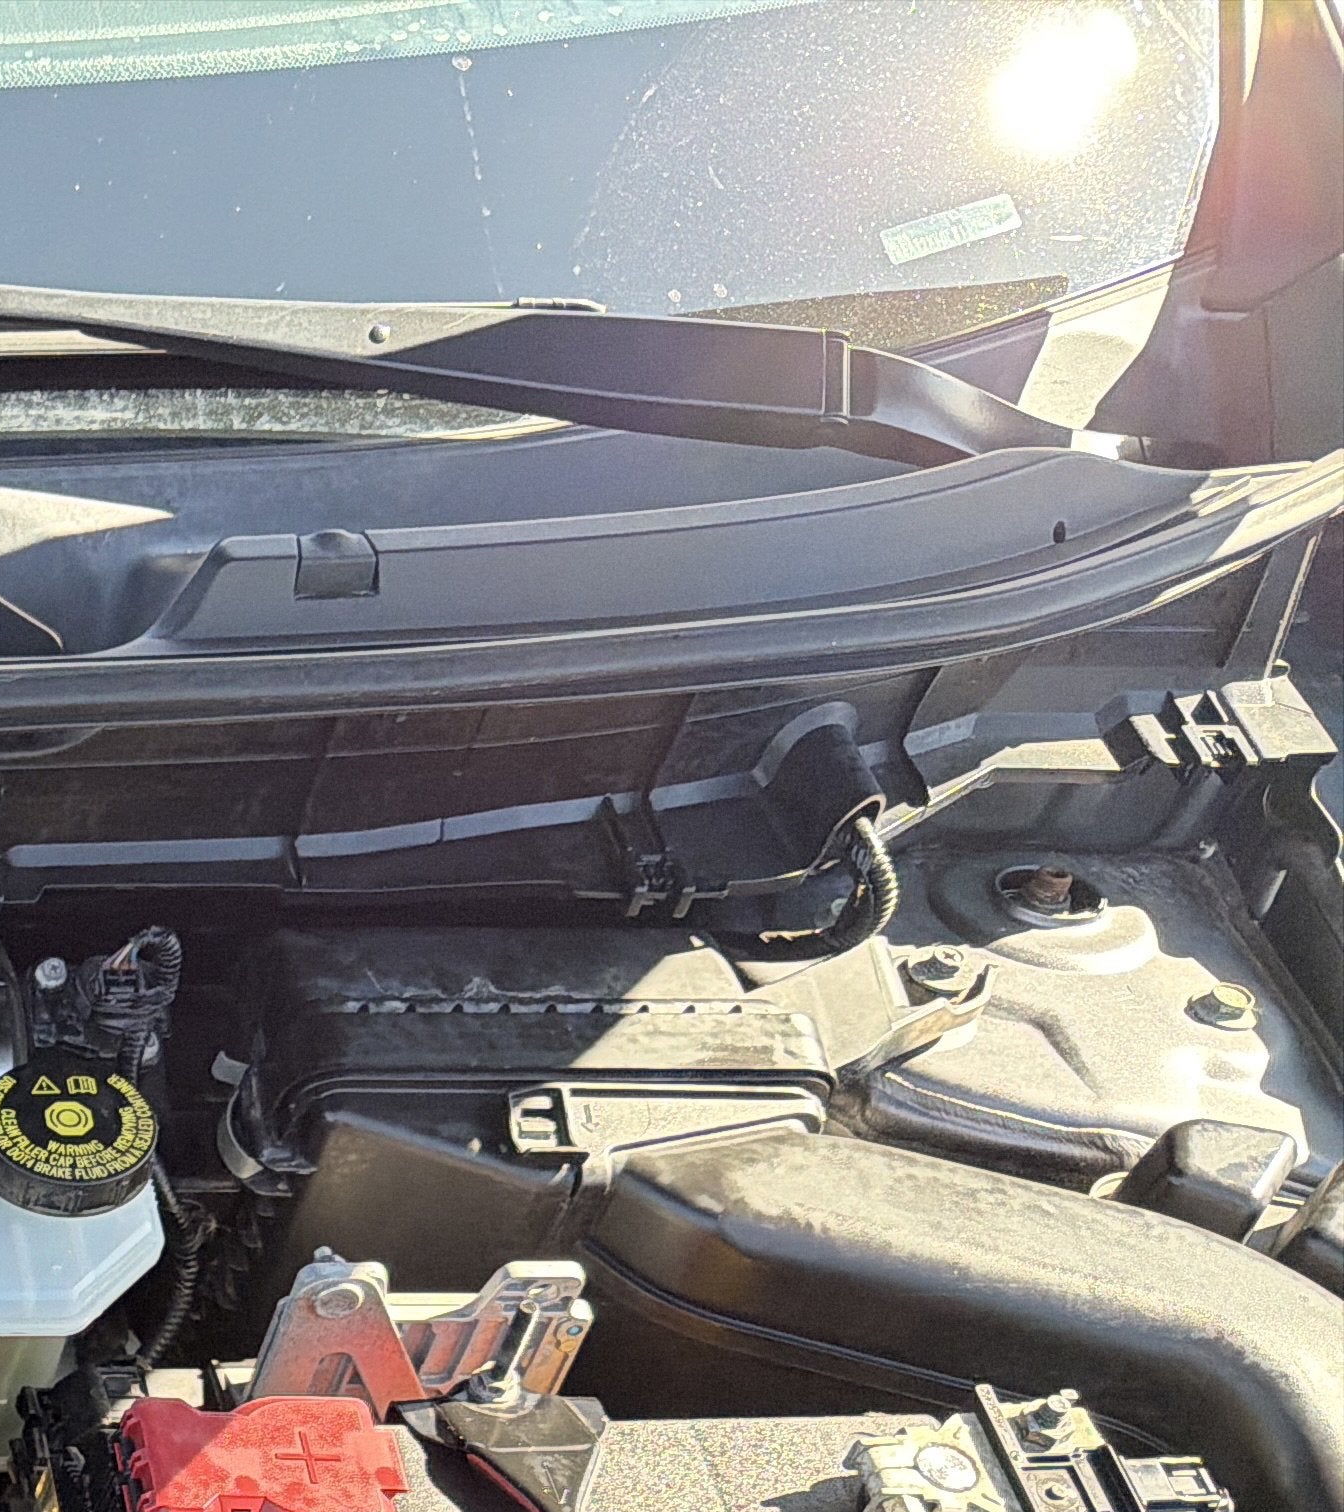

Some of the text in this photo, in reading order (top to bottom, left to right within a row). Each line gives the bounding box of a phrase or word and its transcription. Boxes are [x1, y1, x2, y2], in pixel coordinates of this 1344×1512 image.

[107, 1073, 153, 1118] CONTAINER
[1, 1106, 137, 1168] CLEAN FILLER CAP BEFORE REMOVING
[134, 1118, 154, 1151] SEALED
[47, 1139, 104, 1156] WARNING
[34, 1162, 73, 1179] BRAKE
[75, 1166, 109, 1180] FLUID
[105, 1155, 136, 1175] FROM
